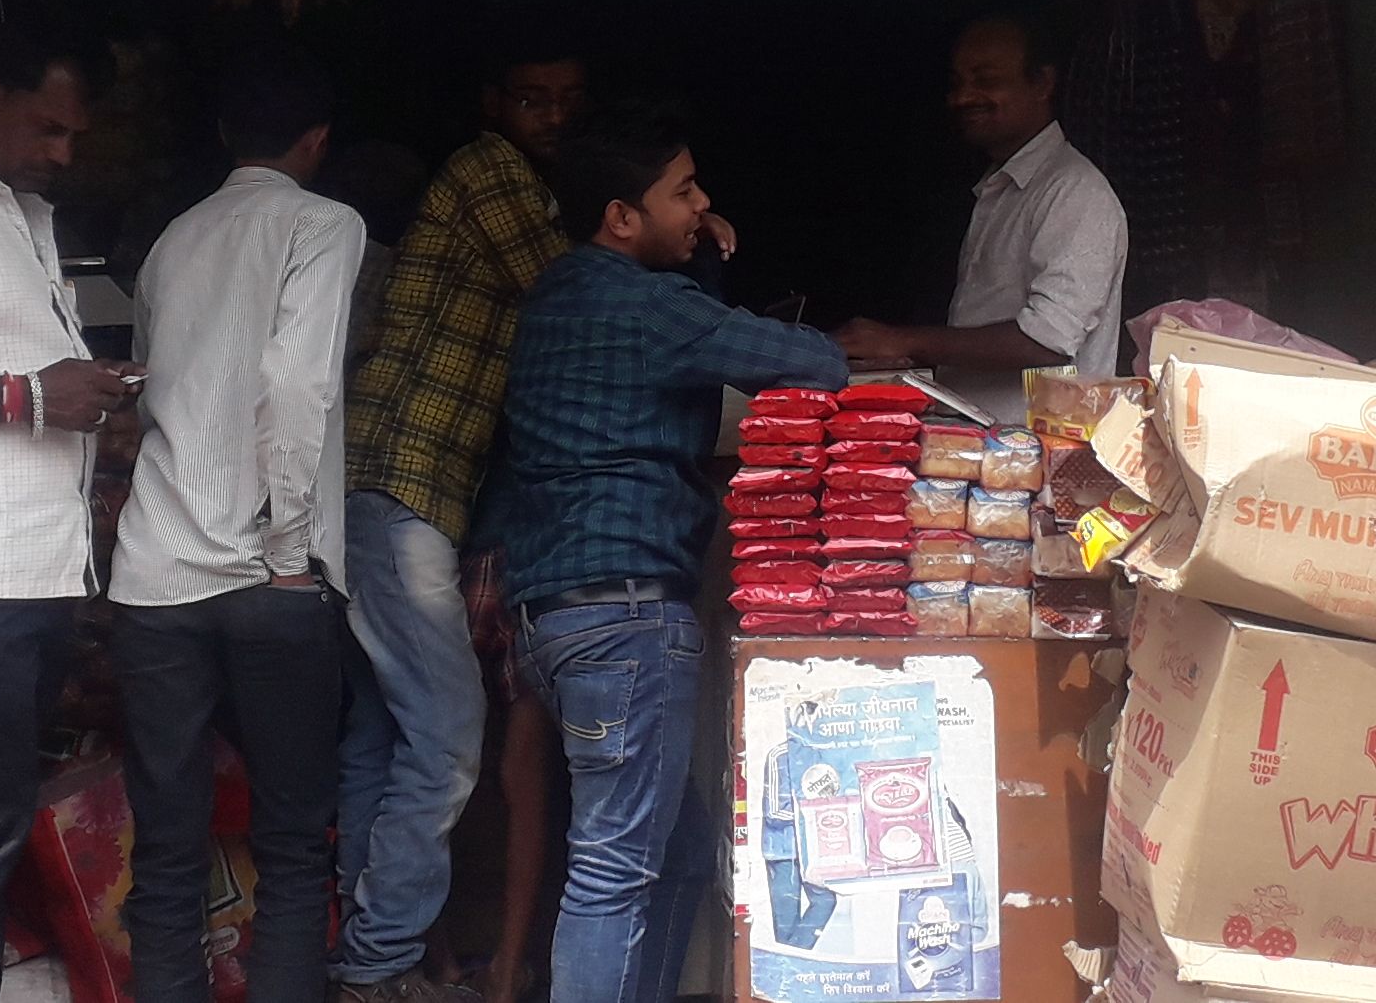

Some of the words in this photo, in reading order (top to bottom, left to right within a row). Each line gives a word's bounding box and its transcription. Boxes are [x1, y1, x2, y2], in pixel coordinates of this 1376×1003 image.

[1234, 497, 1304, 534] SEV
[1250, 752, 1281, 765] THIS
[1248, 763, 1280, 776] SIDE
[1253, 775, 1272, 785] UP
[918, 933, 952, 949] Wash
